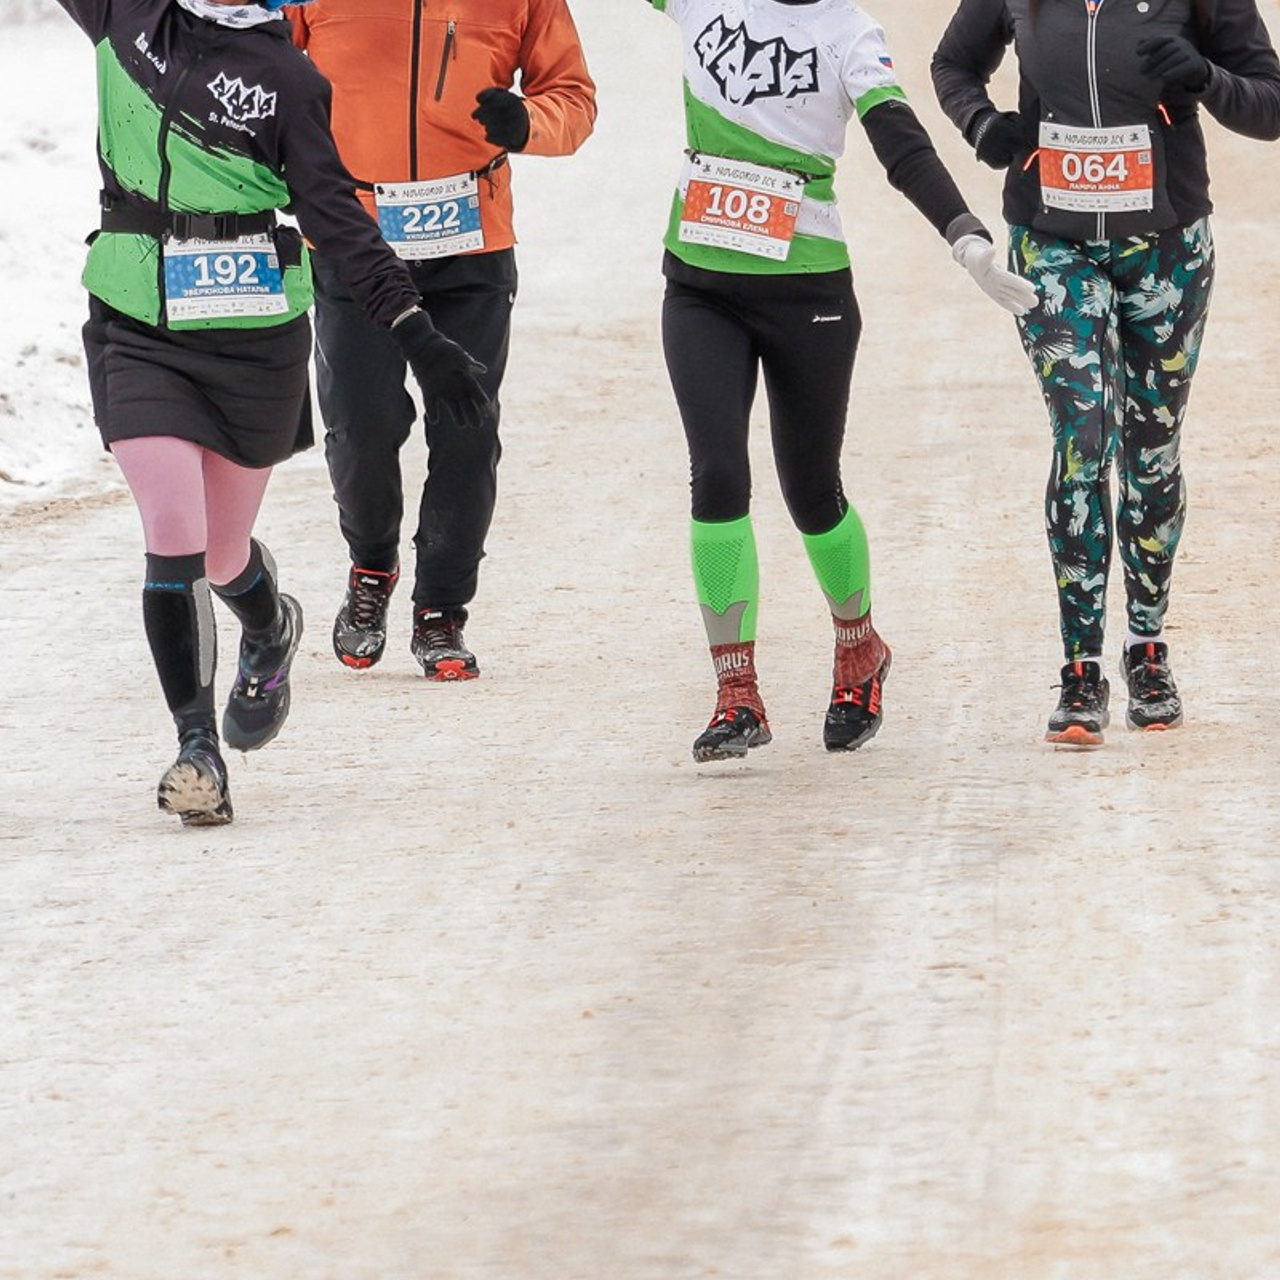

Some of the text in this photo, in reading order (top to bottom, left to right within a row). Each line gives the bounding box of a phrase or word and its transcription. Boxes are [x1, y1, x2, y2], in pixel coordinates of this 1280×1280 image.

[1062, 153, 1128, 183] 064
[402, 201, 461, 233] 222
[705, 186, 771, 224] 108
[193, 254, 259, 286] 192
